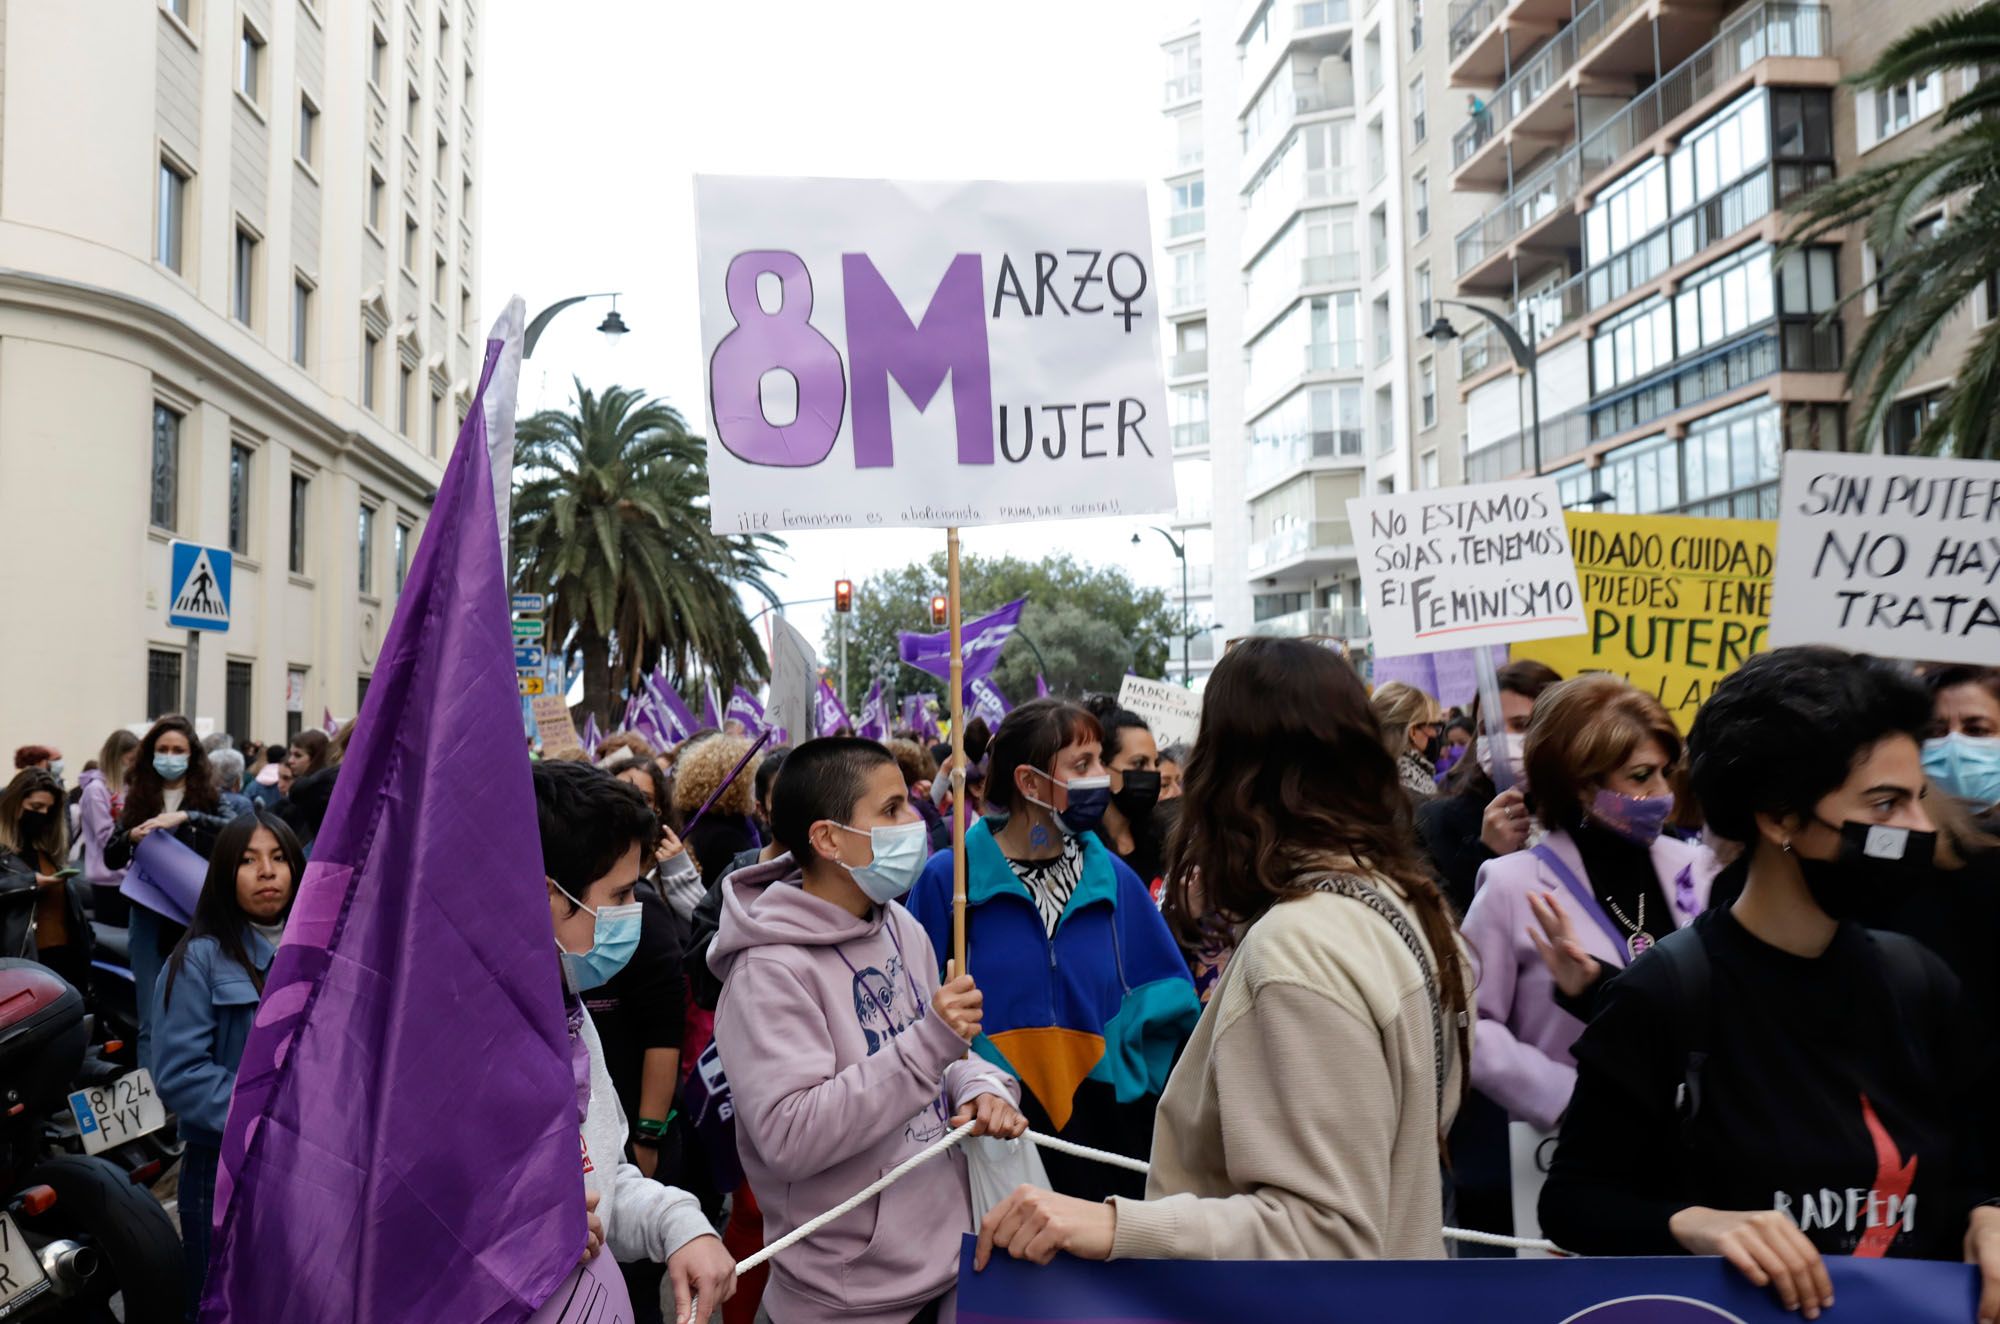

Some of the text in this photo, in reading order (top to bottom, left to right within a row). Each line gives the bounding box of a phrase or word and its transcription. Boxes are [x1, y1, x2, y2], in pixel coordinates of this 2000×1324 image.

[999, 398, 1154, 463] UJER
[866, 511, 883, 524] es
[901, 504, 981, 522] abolicionista
[1798, 472, 1873, 517] SIN
[1370, 492, 1549, 540] NO ESTAMOS
[1458, 526, 1565, 566] TENEMOS
[1811, 529, 1909, 580] NO
[1584, 573, 1683, 609] PUEDES
[1836, 589, 2000, 637] TRATA
[1127, 681, 1187, 706] MADRES
[91, 1075, 151, 1115] 8724
[82, 1104, 143, 1142] E FYY
